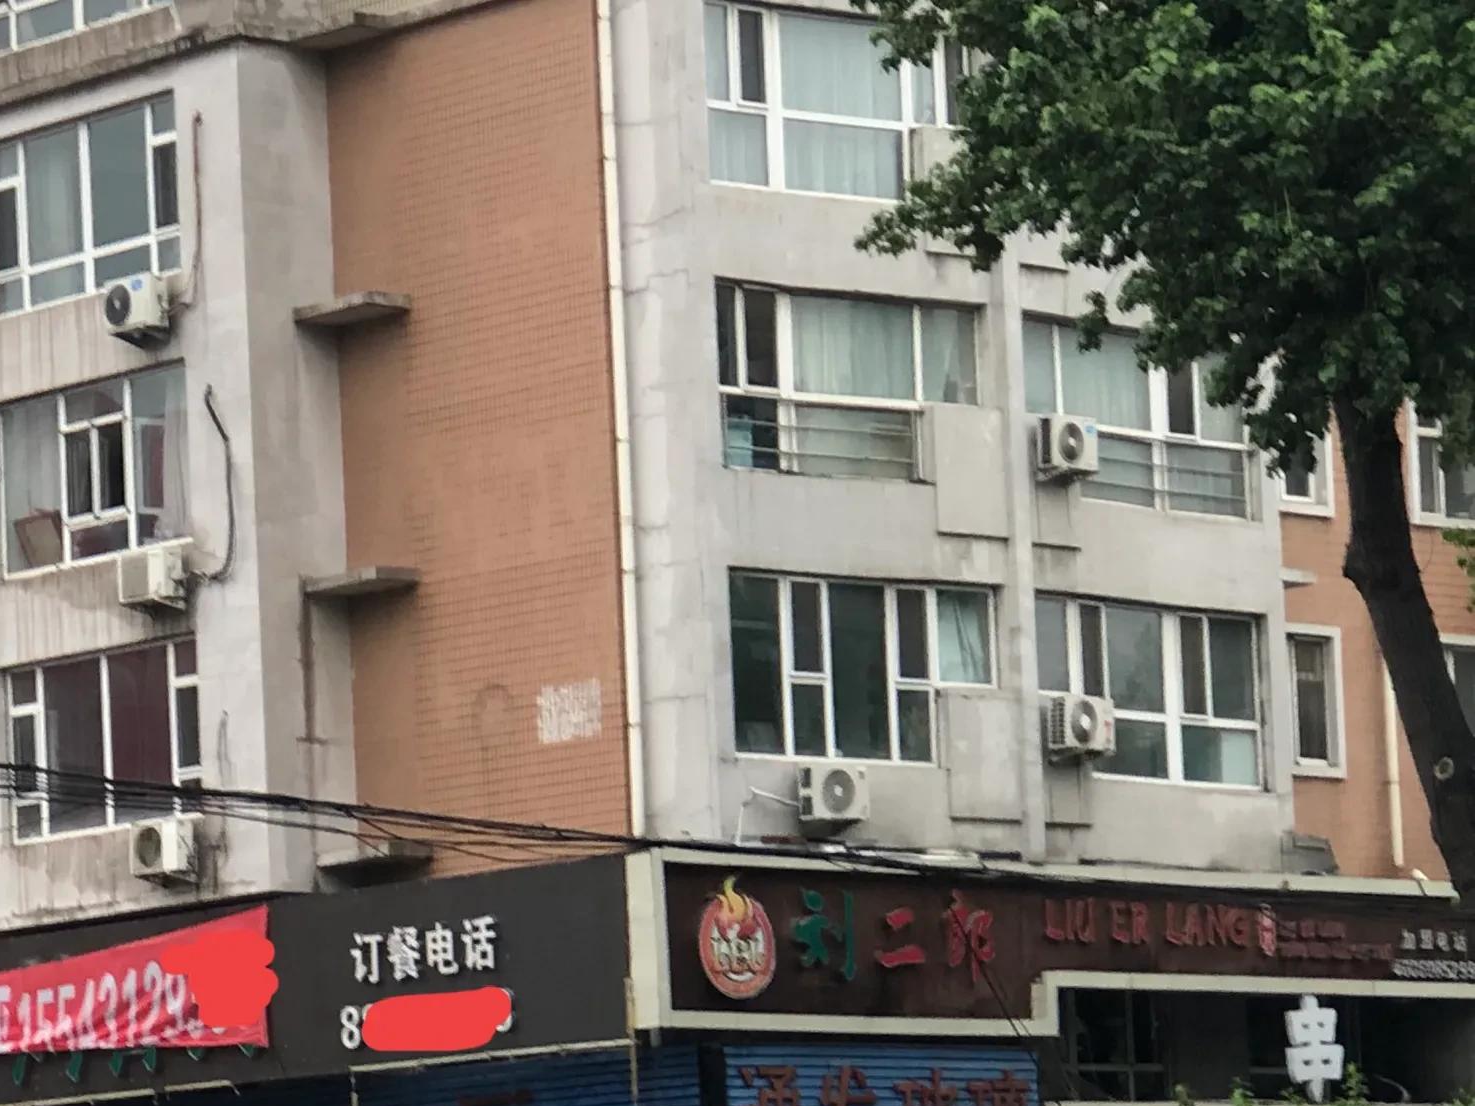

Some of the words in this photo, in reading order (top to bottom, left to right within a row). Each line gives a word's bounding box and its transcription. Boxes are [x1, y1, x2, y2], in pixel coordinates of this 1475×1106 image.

[350, 915, 497, 984] 订餐电话
[790, 888, 996, 980] 刘二郎
[1044, 897, 1097, 945] LIU
[1110, 901, 1150, 945] ER
[1164, 901, 1251, 948] LANG
[1284, 994, 1345, 1103] 串
